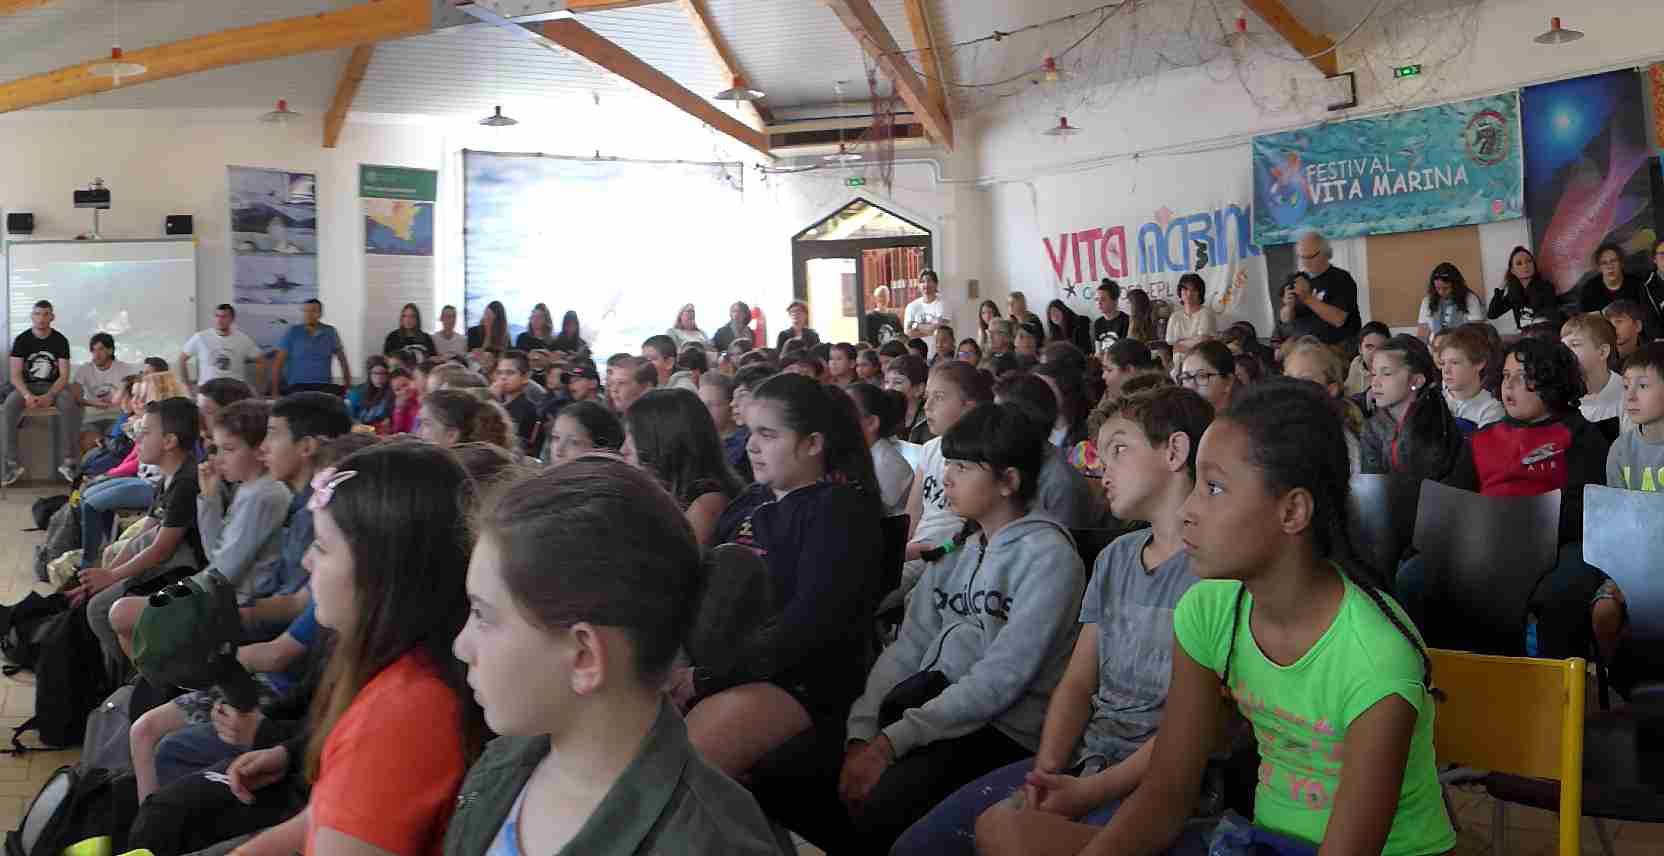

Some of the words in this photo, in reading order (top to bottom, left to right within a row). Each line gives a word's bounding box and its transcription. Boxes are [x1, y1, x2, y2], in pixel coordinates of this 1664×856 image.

[1306, 155, 1395, 182] FESTIVAL
[1310, 179, 1363, 204] VITA
[1372, 164, 1469, 197] MARINA
[1137, 206, 1262, 273] MARIN
